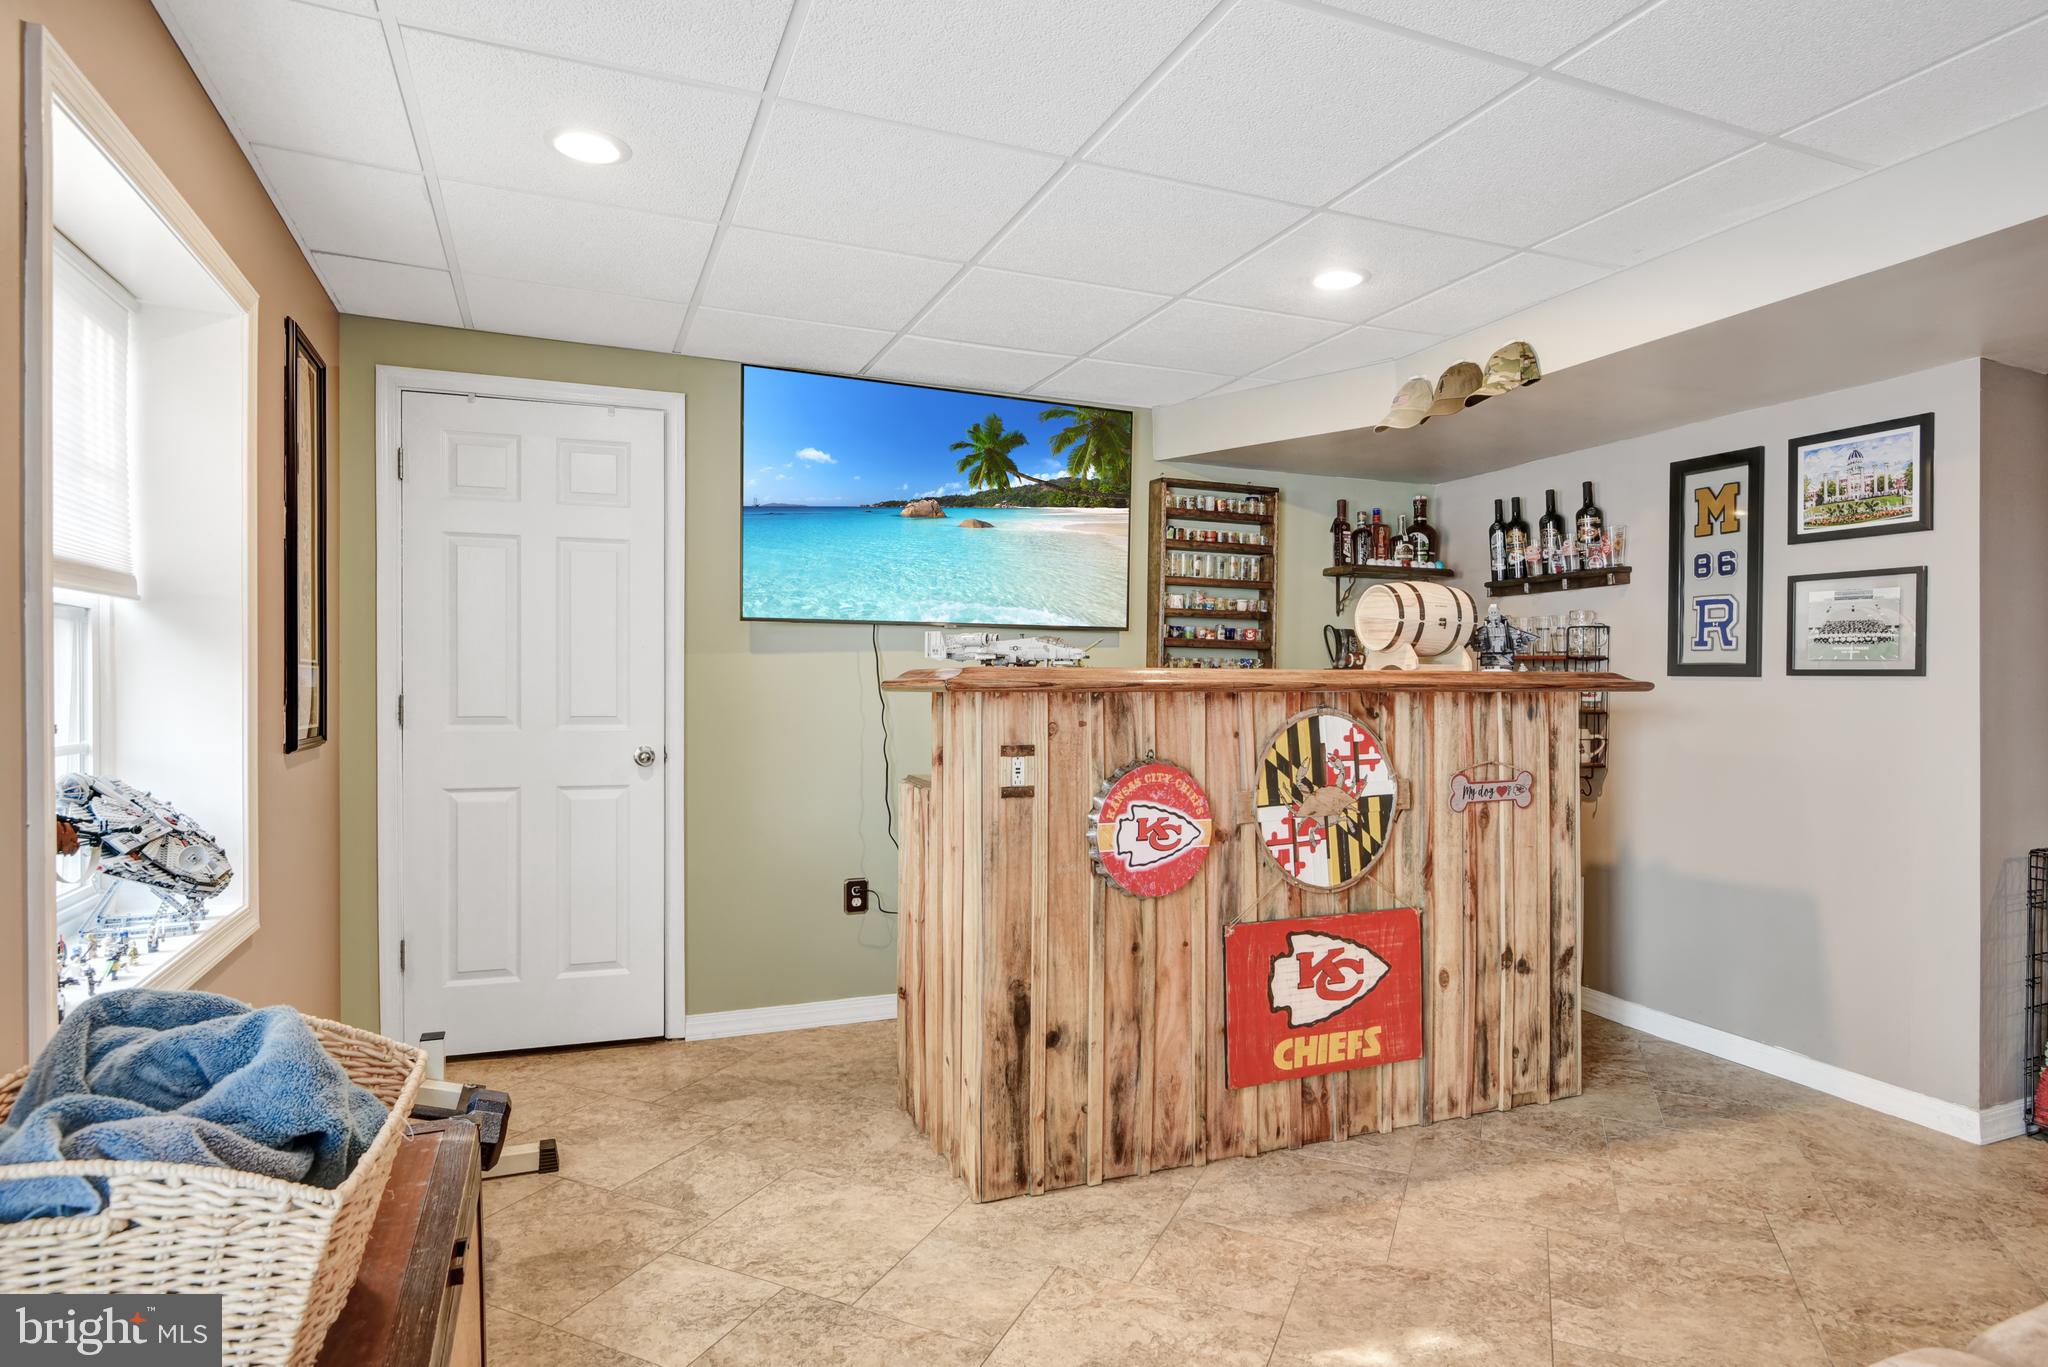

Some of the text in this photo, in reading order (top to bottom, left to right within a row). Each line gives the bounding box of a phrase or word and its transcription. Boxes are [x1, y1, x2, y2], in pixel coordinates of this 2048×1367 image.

[1694, 481, 1741, 538] M
[1694, 549, 1738, 580] 86
[1691, 594, 1738, 651] R
[1106, 772, 1205, 820] KANSAS CITY CHIEFS
[1462, 785, 1477, 800] My
[1477, 784, 1495, 799] dog
[1136, 817, 1182, 851] KC
[1296, 947, 1364, 1001] KC
[1273, 1025, 1382, 1071] CHIEFS
